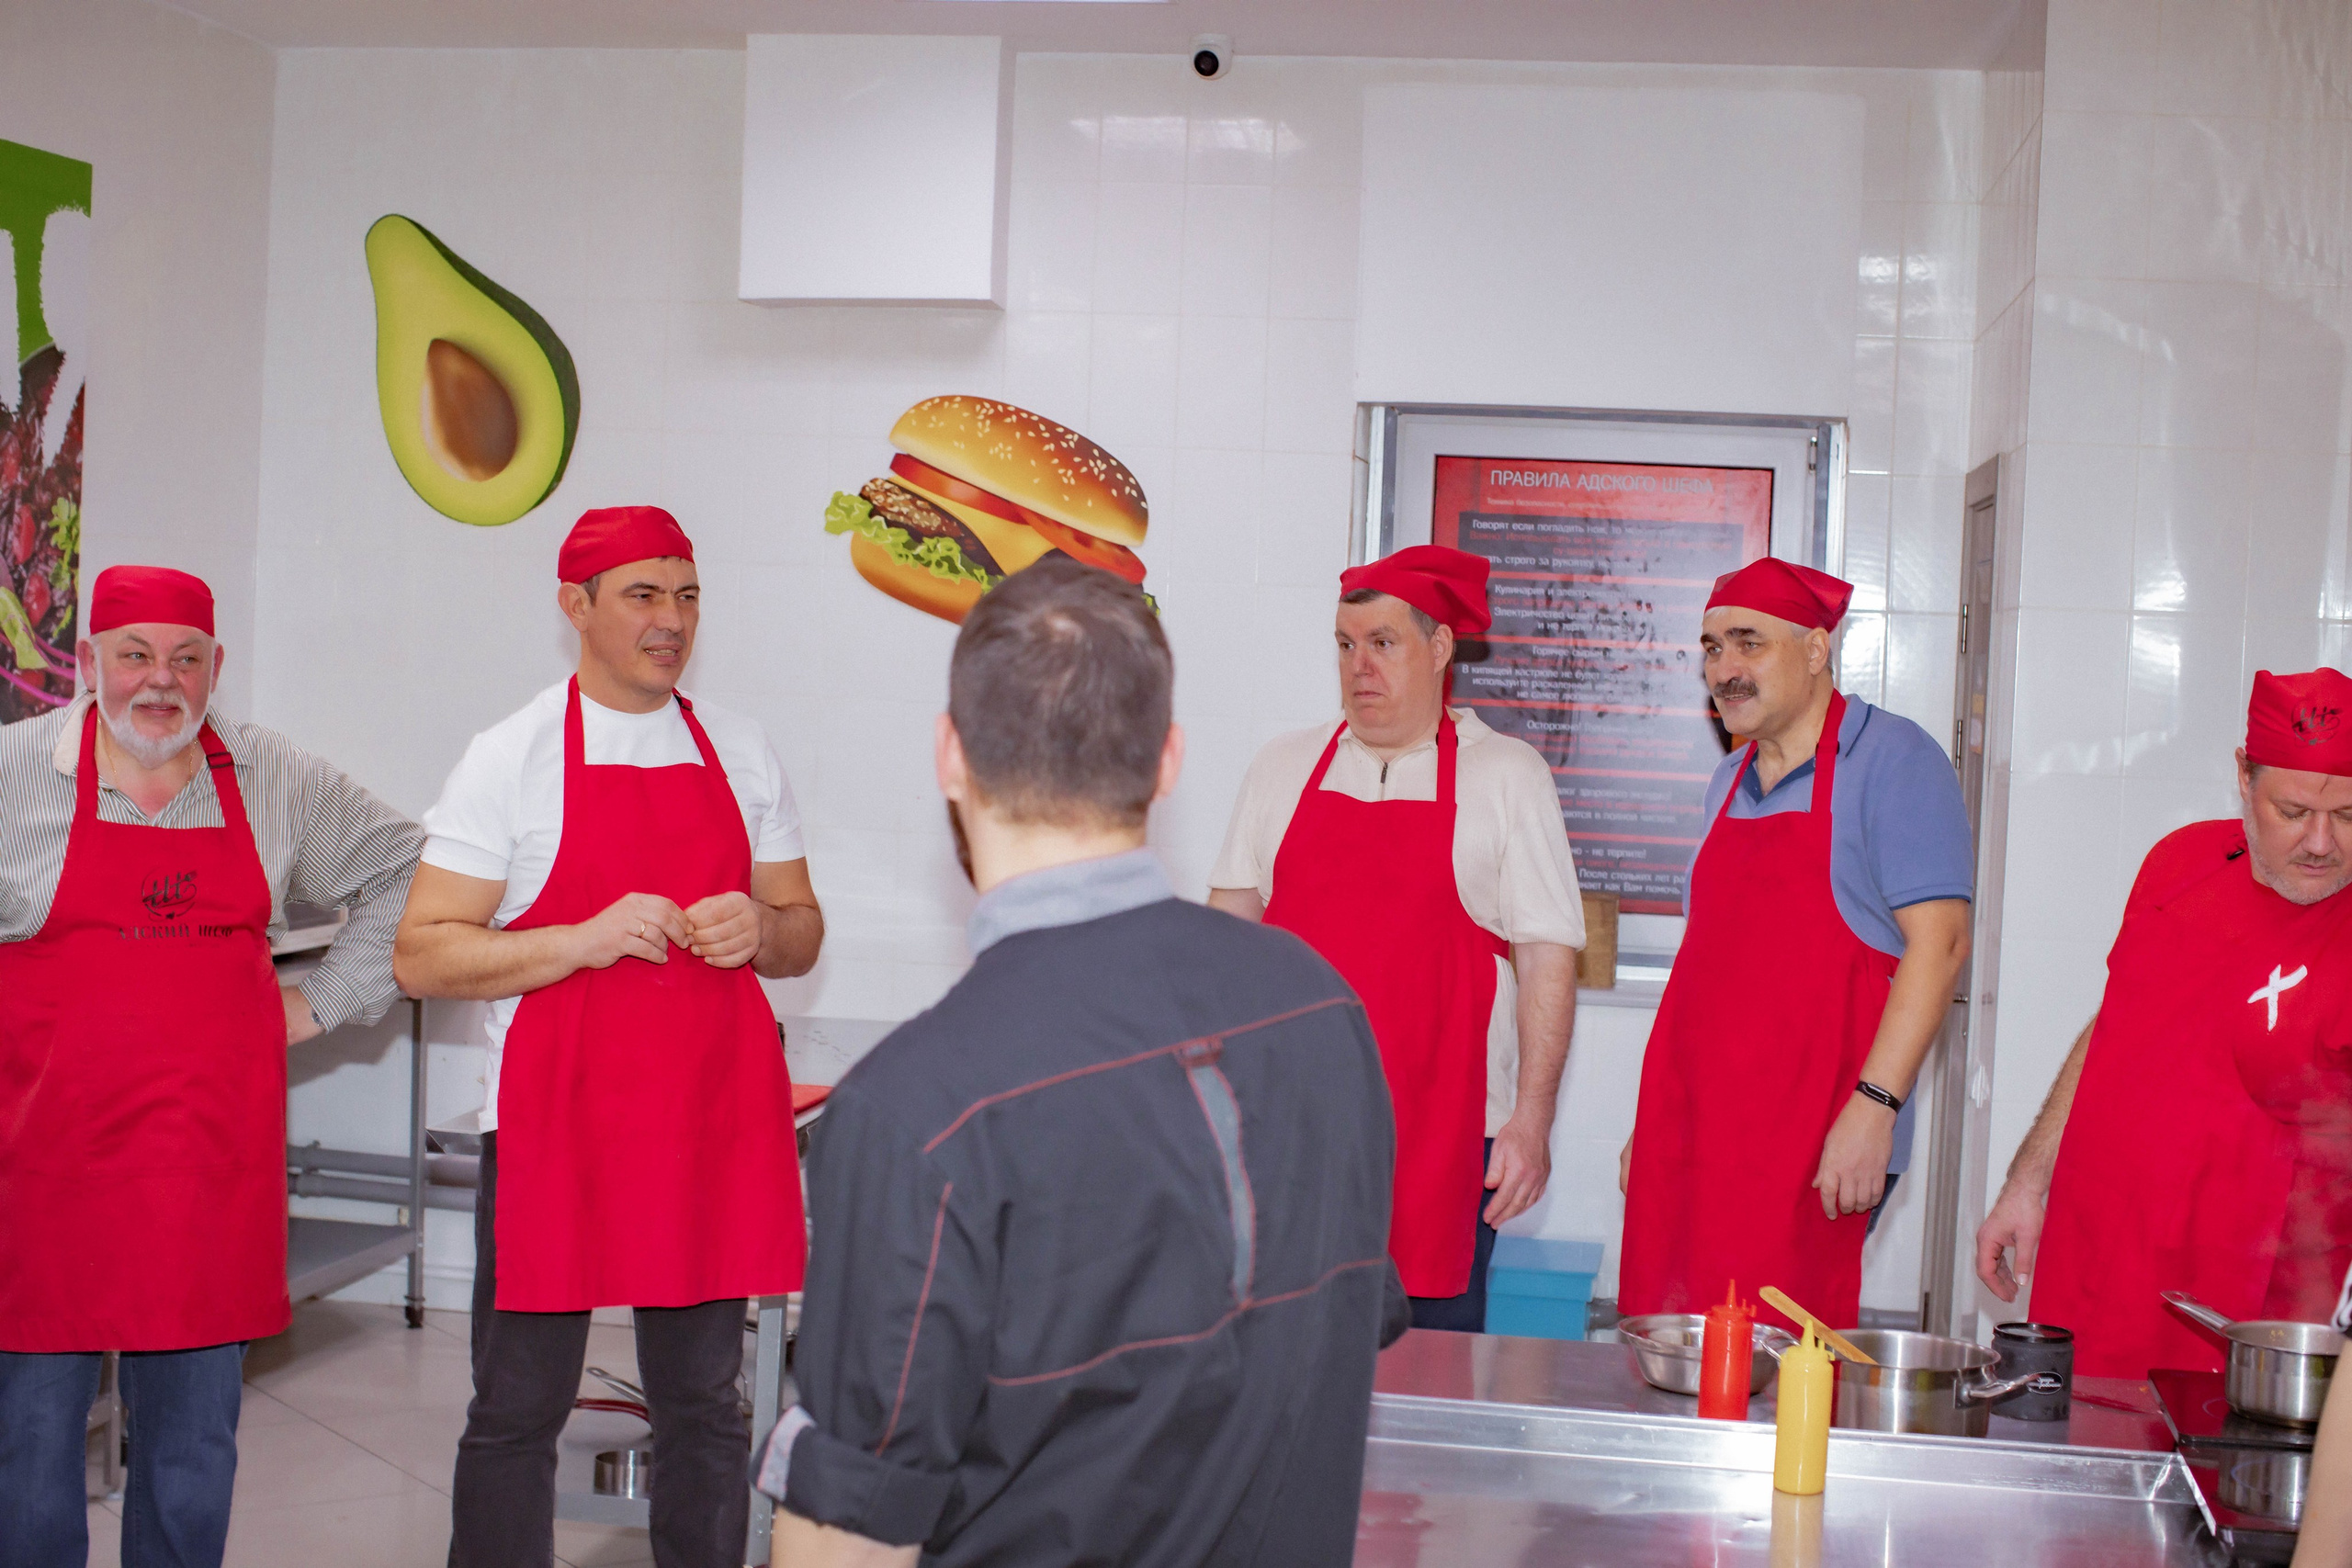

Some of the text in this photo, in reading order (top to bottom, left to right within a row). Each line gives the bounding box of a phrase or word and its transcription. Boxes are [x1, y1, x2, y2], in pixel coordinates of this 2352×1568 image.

[1490, 469, 1714, 493] ПРАВИЛА АДСКОГО ШЕФА
[1472, 519, 1510, 531] Говорят
[1511, 522, 1535, 531] если
[1537, 524, 1585, 534] погладить
[1505, 556, 1536, 567] строго
[1538, 557, 1550, 566] за
[1494, 584, 1545, 597] Кулинария
[1494, 606, 1565, 619] Электричество
[1462, 664, 1469, 673] В
[1471, 666, 1512, 676] кипящей
[1515, 669, 1558, 679] кастрюле
[1561, 671, 1573, 679] не
[1575, 671, 1600, 681] будет
[1472, 678, 1529, 688] используйте
[1531, 691, 1559, 700] самое
[1527, 719, 1580, 732] Осторожно!
[1591, 848, 1604, 856] не
[1578, 867, 1608, 879] После
[1611, 872, 1652, 882] стольких
[1655, 874, 1670, 883] лет
[1604, 883, 1621, 891] как
[1623, 882, 1643, 892] Вам
